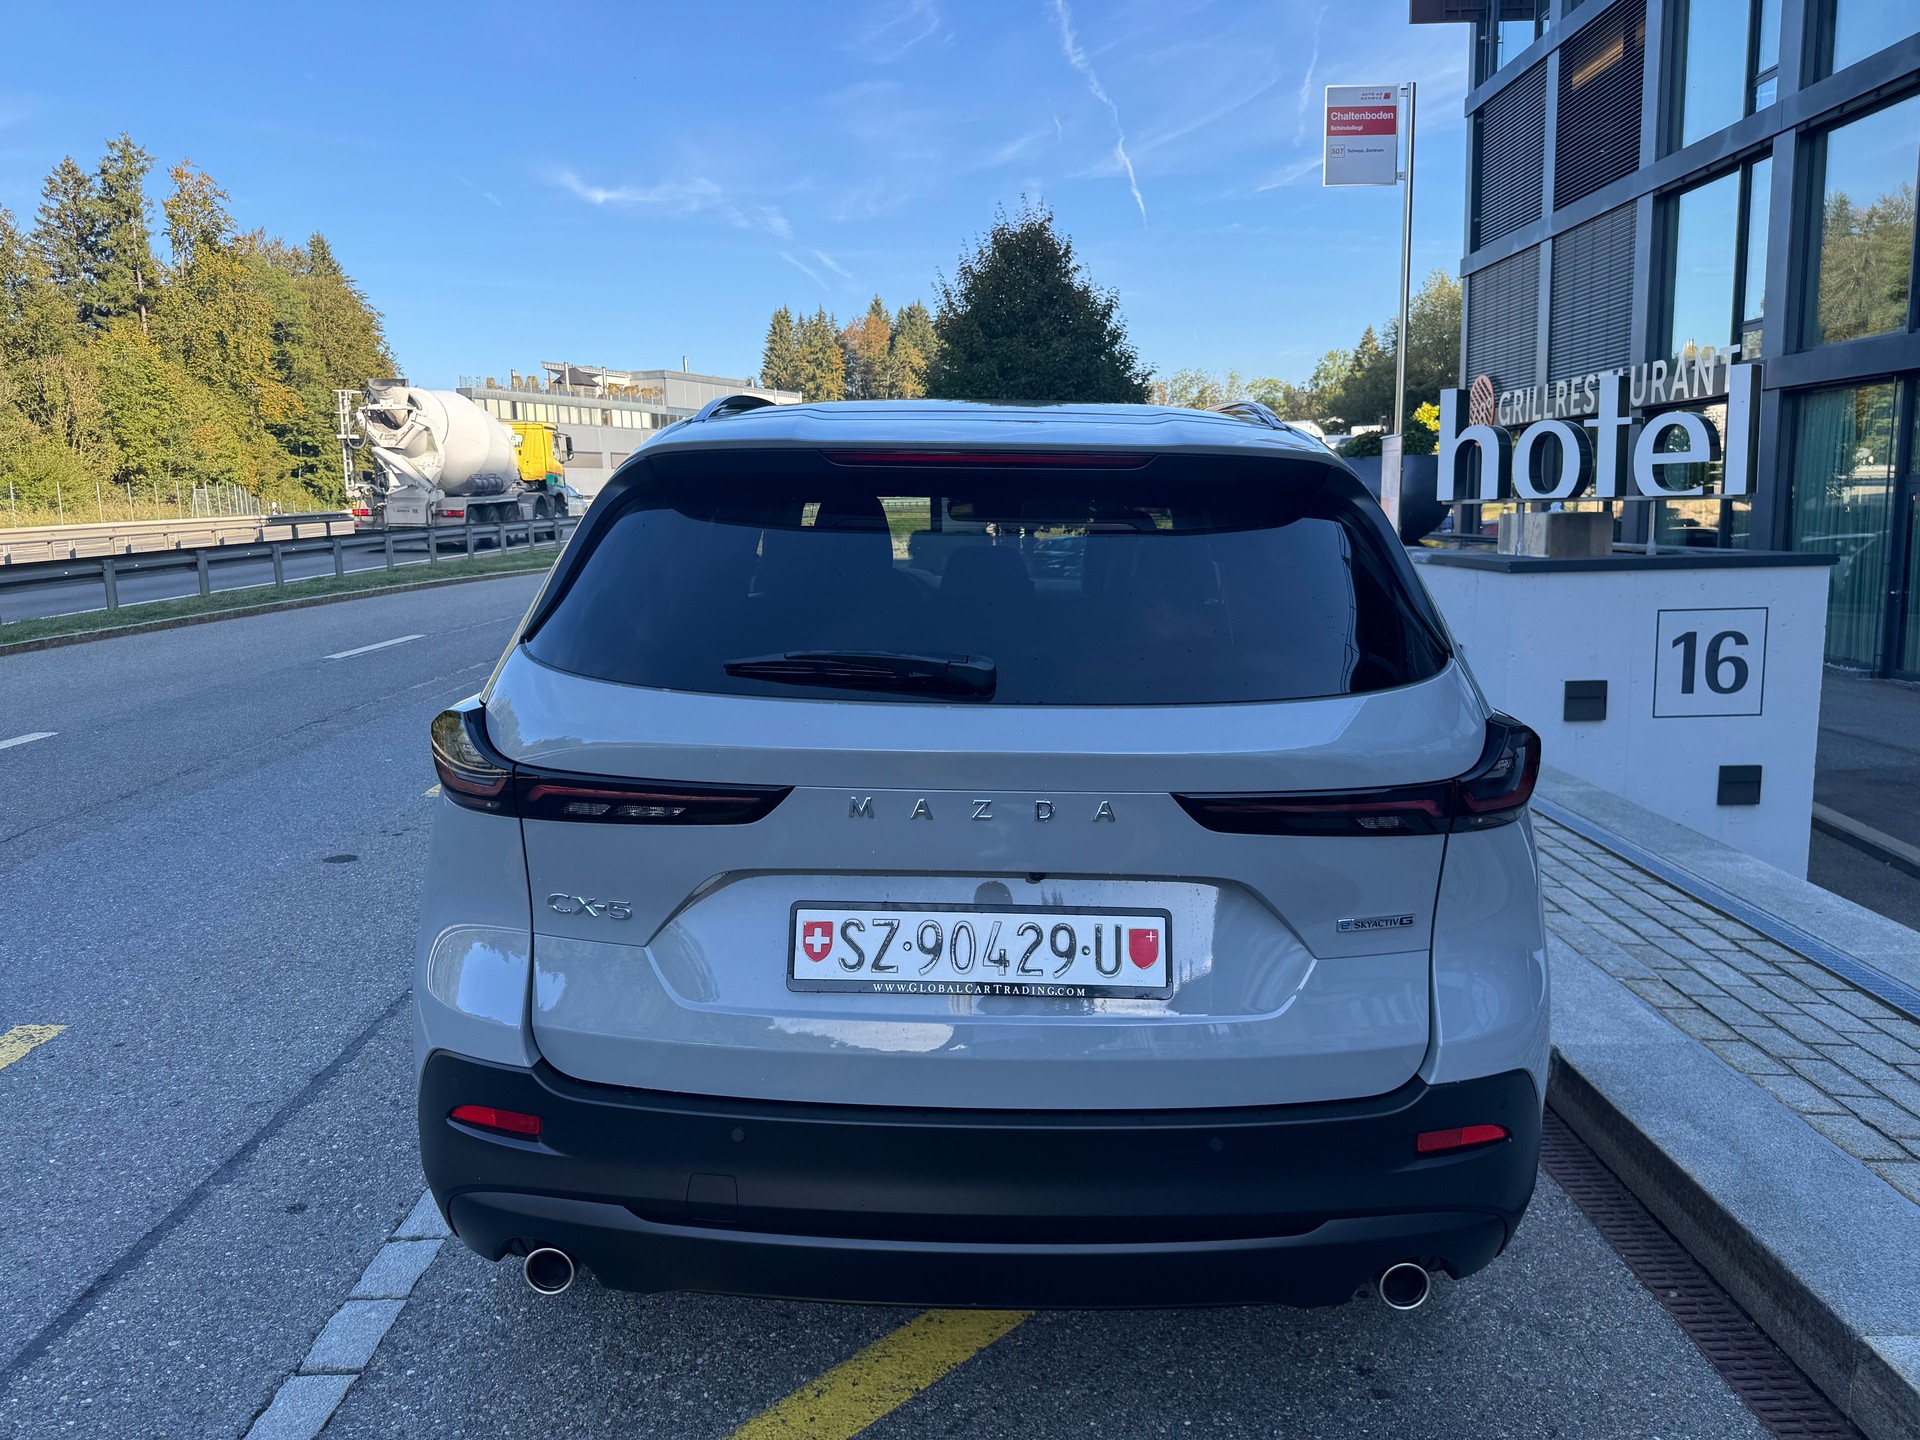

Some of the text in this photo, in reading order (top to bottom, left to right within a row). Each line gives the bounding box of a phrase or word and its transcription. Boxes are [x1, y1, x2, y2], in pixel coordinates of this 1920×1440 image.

[1330, 111, 1394, 120] Chaltenboden
[1498, 344, 1741, 427] GRILLRESURANT
[1436, 363, 1763, 501] hotel
[1671, 630, 1749, 695] 16
[848, 796, 1116, 822] MAZDA
[547, 893, 633, 921] CX-5
